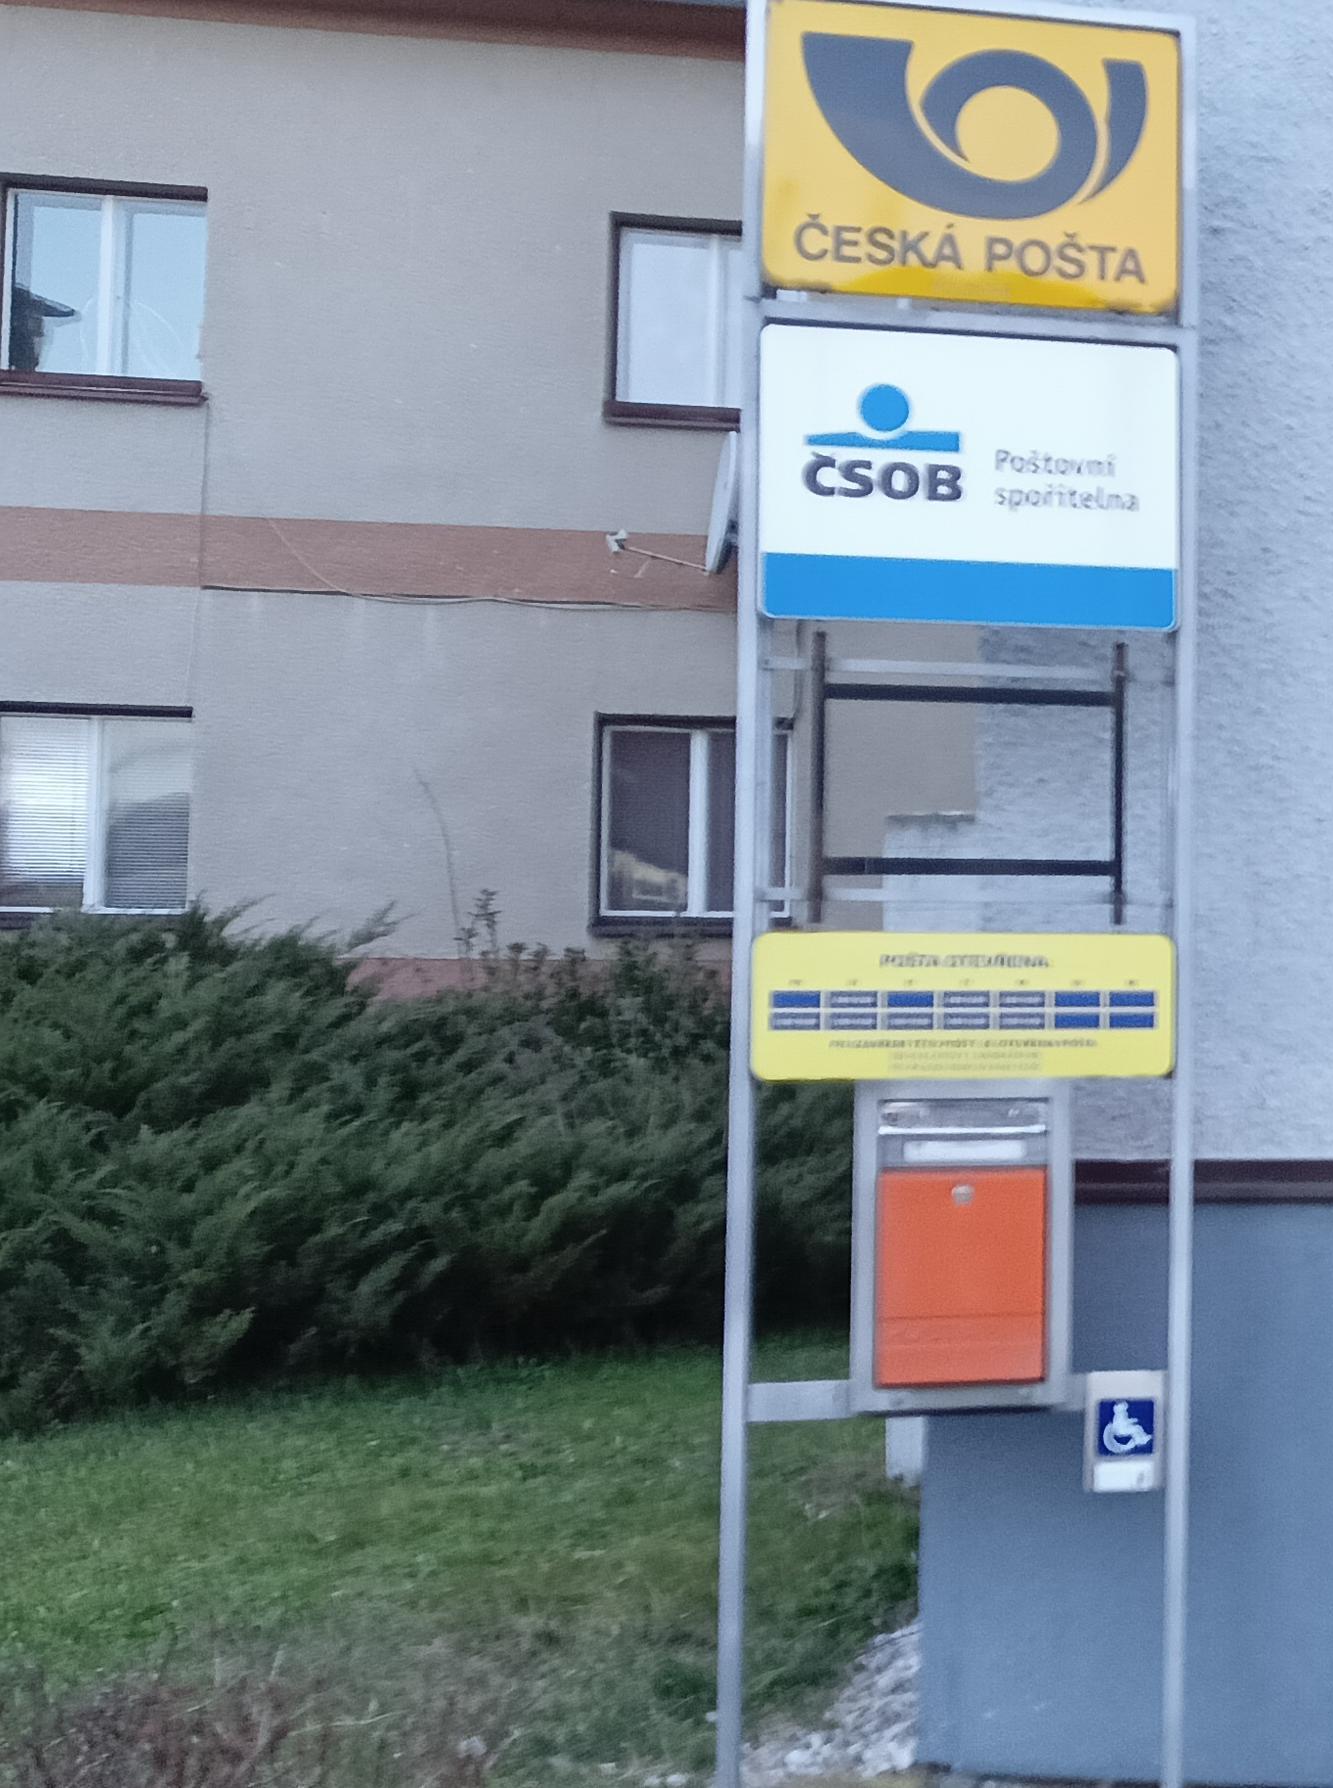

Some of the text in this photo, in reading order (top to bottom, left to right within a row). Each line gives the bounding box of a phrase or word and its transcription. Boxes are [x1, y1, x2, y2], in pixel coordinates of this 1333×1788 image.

[793, 213, 1146, 284] ČESKÁ POŠTA
[802, 451, 963, 502] ČSOB
[994, 448, 1115, 477] Poštovní
[994, 482, 1139, 512] spořitelna
